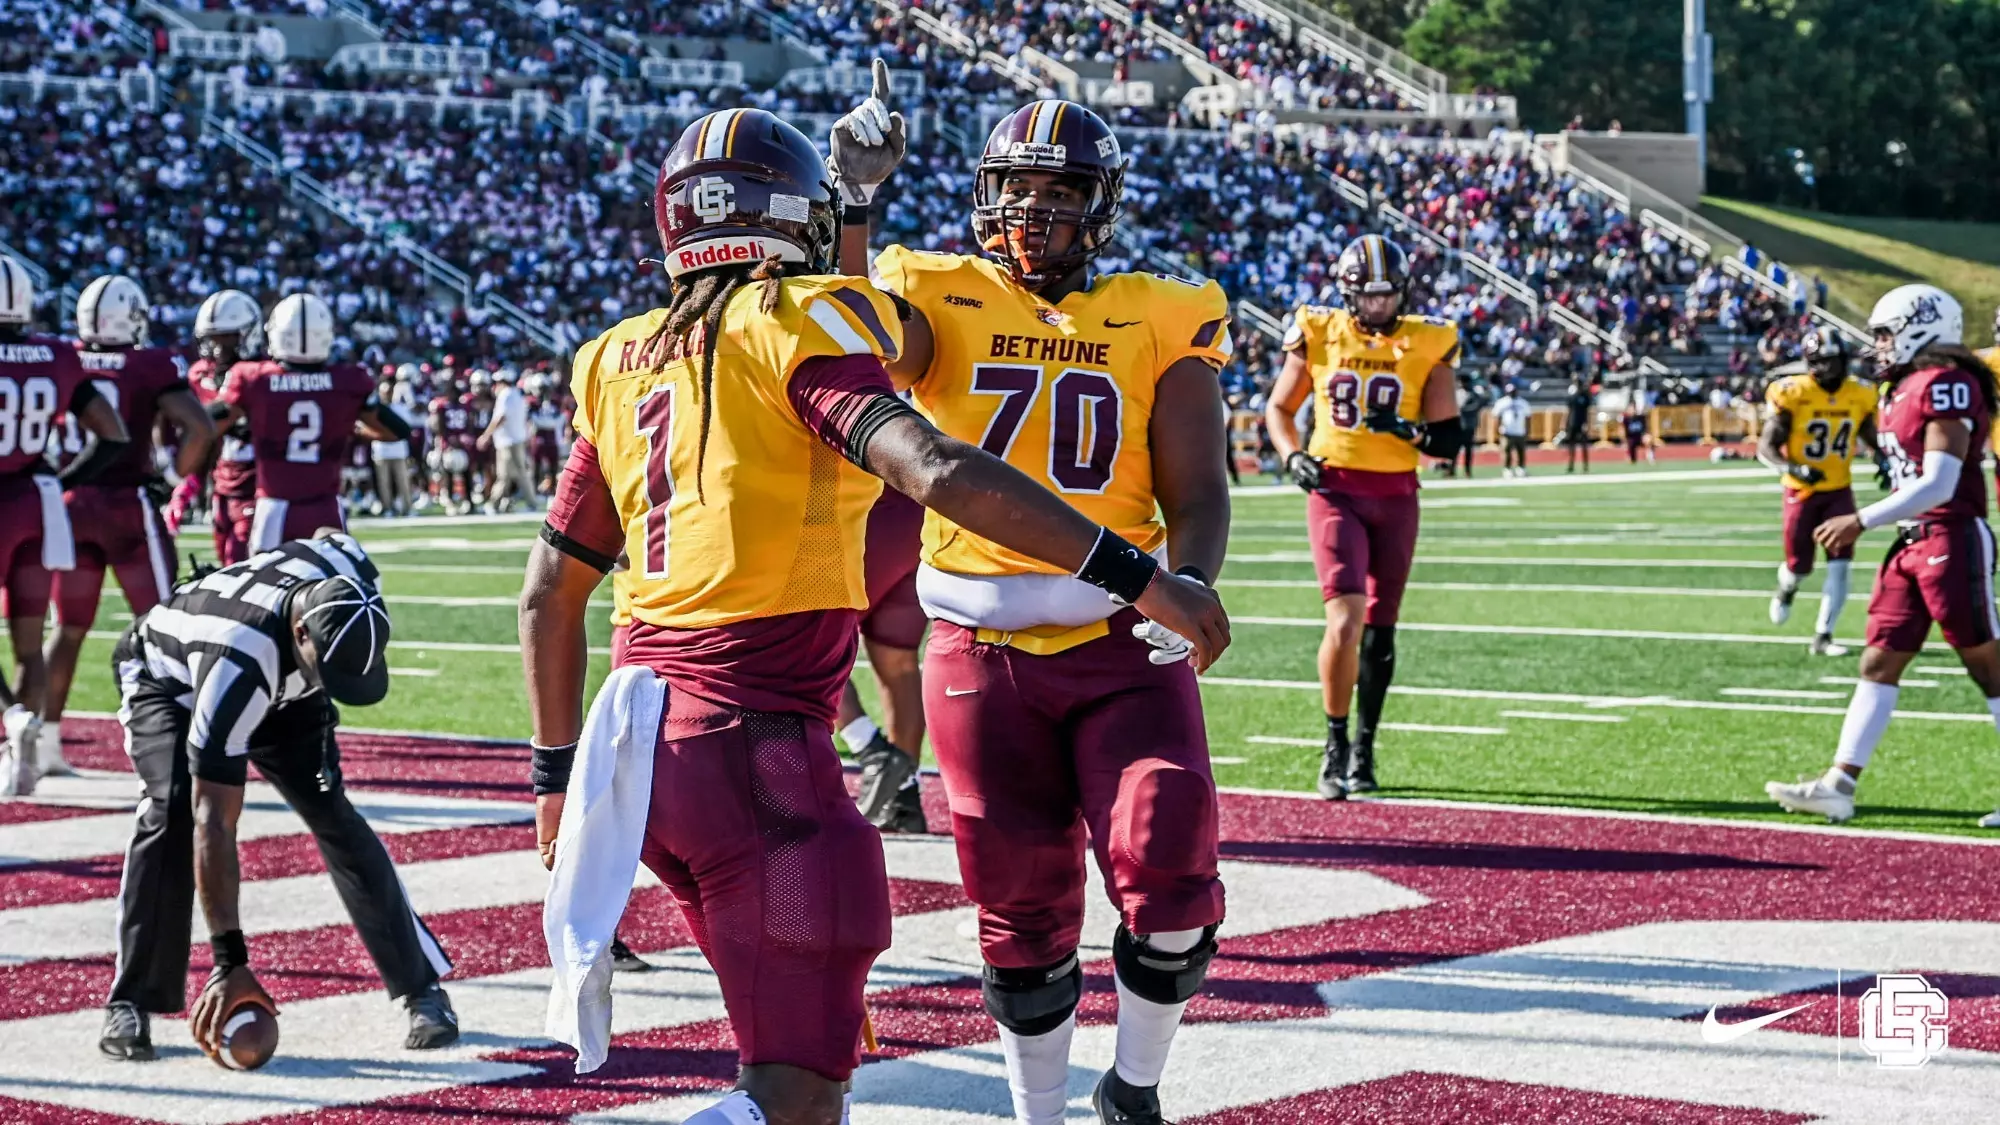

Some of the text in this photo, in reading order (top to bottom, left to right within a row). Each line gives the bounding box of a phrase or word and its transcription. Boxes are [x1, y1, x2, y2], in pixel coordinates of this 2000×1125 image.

[1024, 145, 1054, 154] Riddell
[678, 240, 766, 270] Riddell
[952, 296, 983, 309] SWAC
[989, 334, 1111, 366] BETHUNE
[269, 372, 333, 392] DAWSON
[1931, 382, 1970, 411] 50
[286, 400, 322, 464] 2
[968, 362, 1123, 494] 70
[1803, 418, 1856, 461] 34
[634, 382, 676, 580] 1
